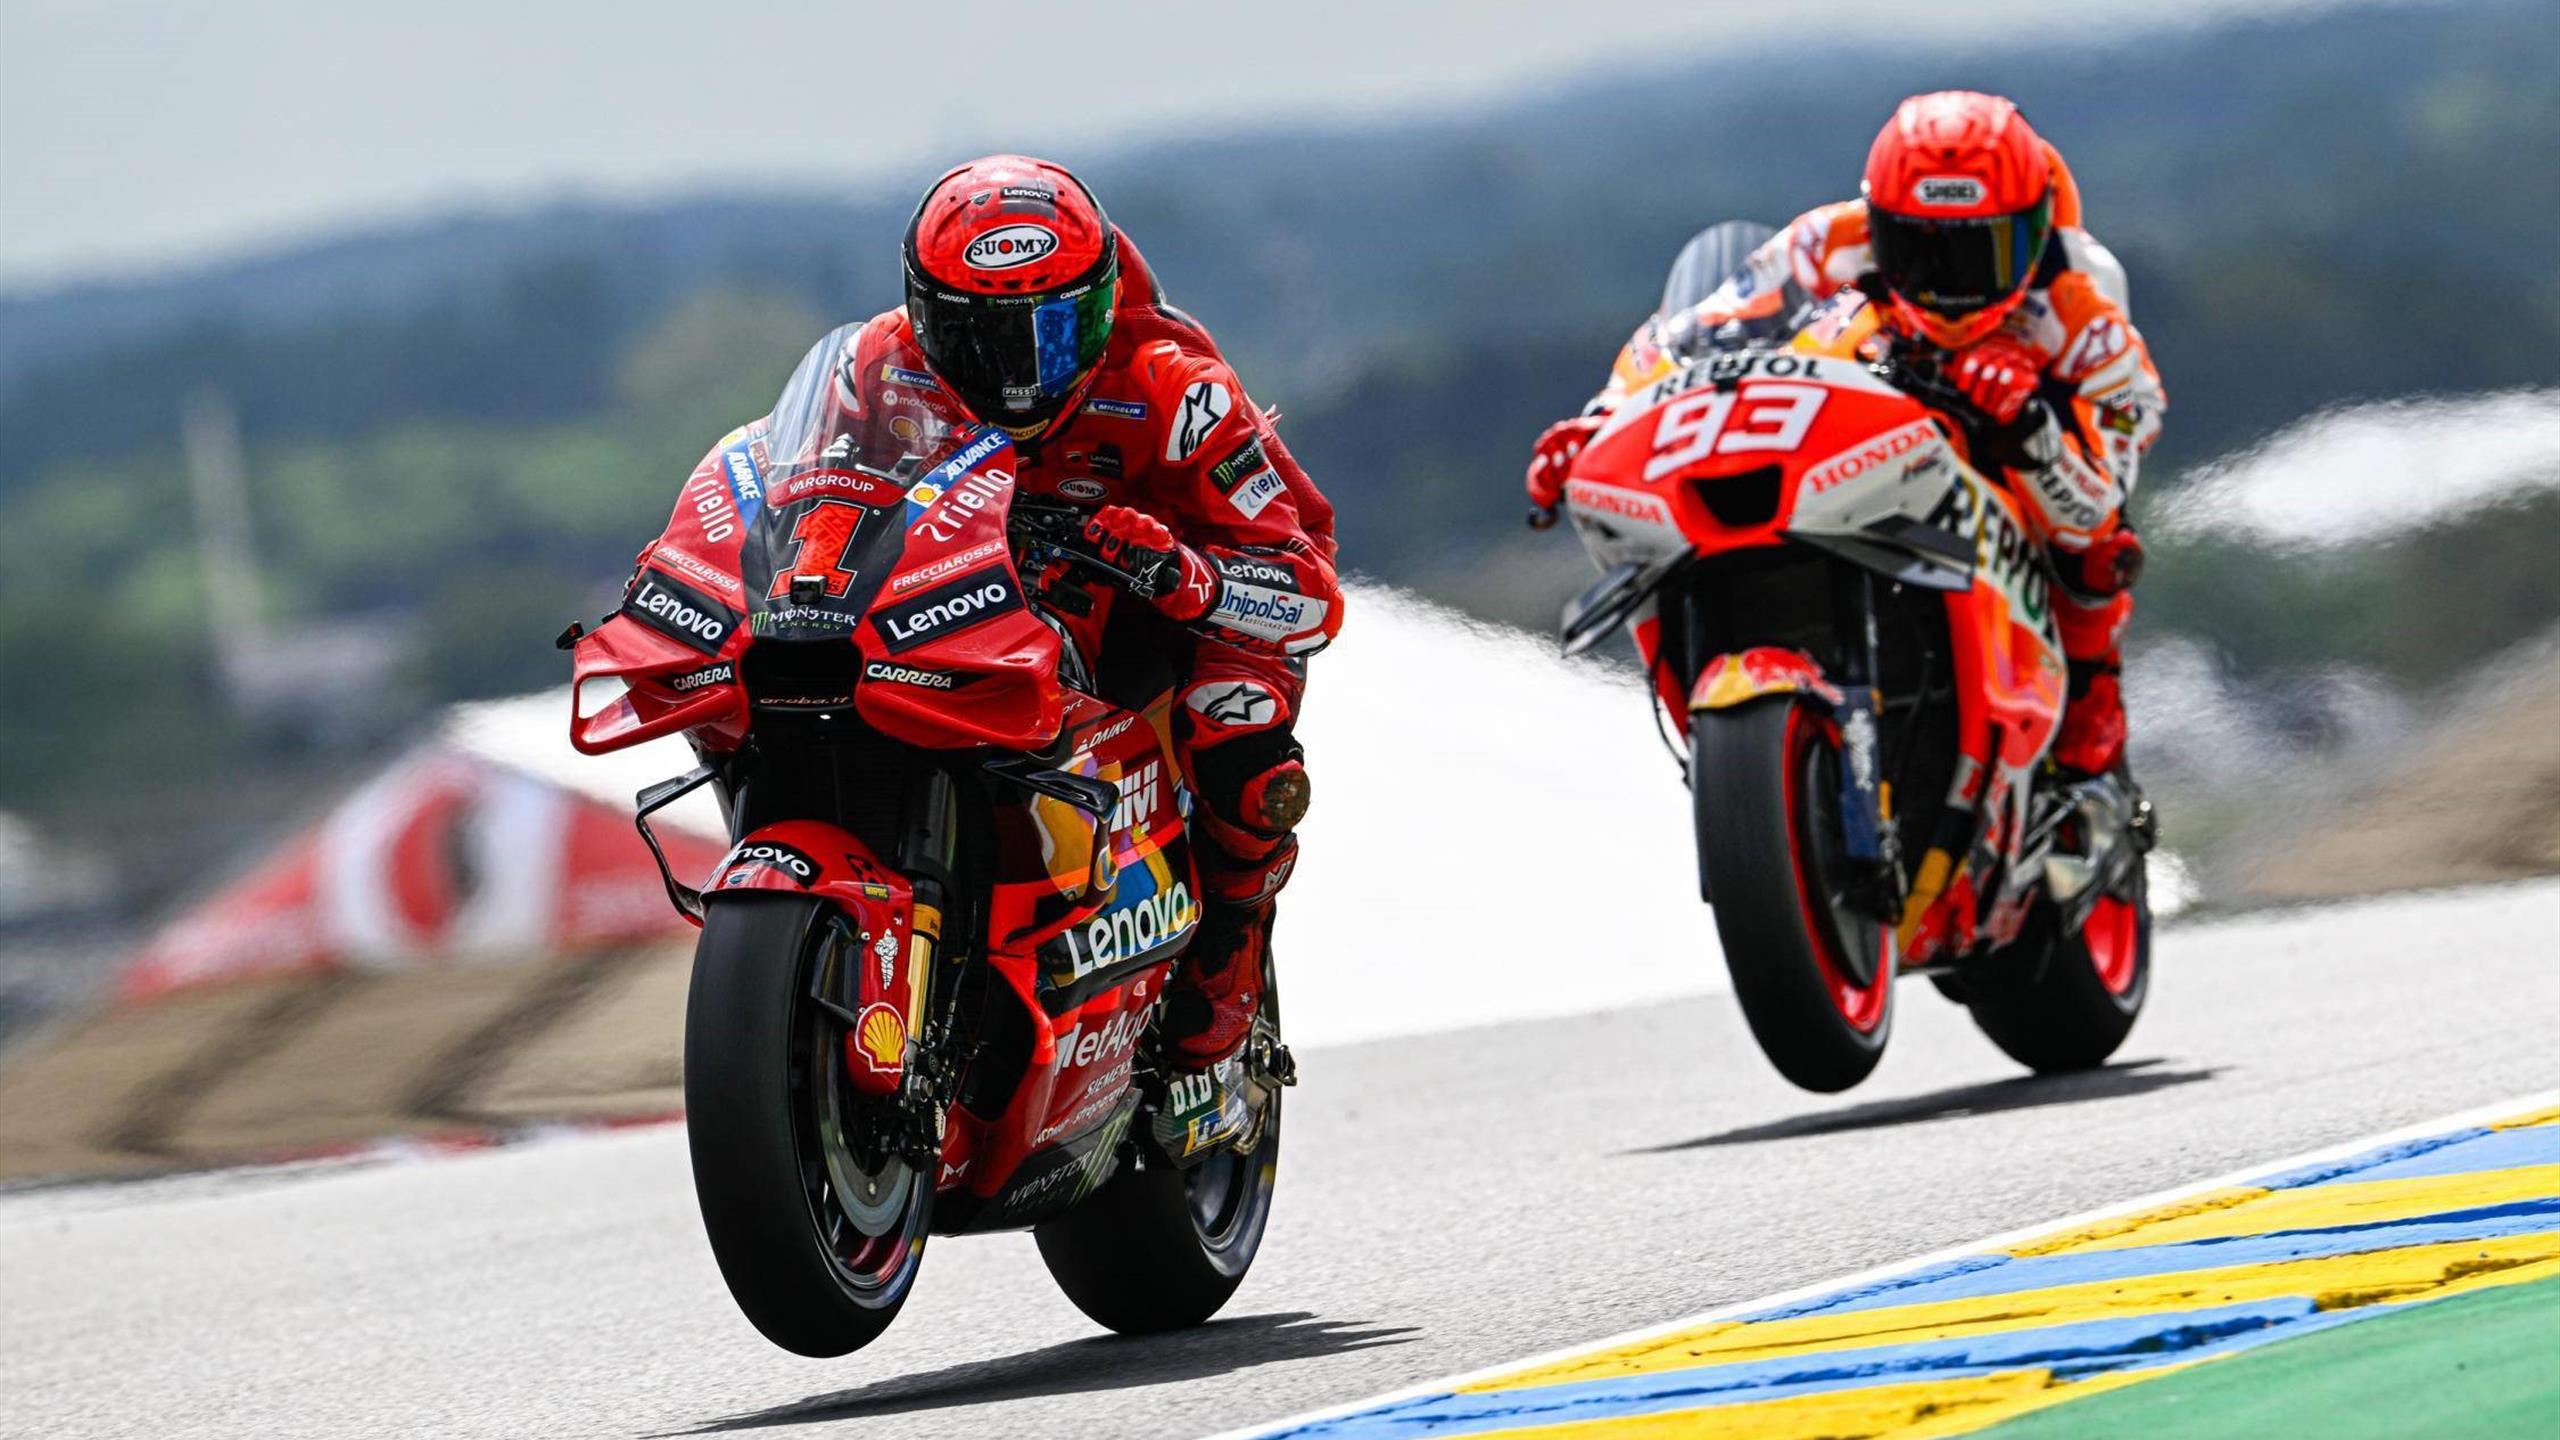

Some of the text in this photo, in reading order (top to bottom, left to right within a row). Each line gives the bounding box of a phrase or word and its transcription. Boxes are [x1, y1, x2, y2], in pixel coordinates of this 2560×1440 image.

[1003, 187, 1051, 201] Lenovo
[972, 239, 1050, 257] SUOMY
[936, 292, 971, 304] CARRERA
[1059, 284, 1092, 300] CARRERA
[900, 396, 948, 414] motorola
[1098, 403, 1141, 415] MICHELIN
[1642, 383, 1829, 483] 93
[944, 431, 1006, 481] ADVANCE
[1812, 424, 1937, 494] HONDA
[727, 451, 762, 500] ADVANCE
[789, 474, 875, 495] VARGROUP
[1569, 487, 1664, 525] HONDA
[765, 500, 867, 601] 1
[657, 546, 740, 593] FRECCIAROSSA
[893, 540, 1004, 593] FRECCIAROSSA
[1217, 559, 1293, 585] Lenovo
[635, 581, 723, 641] Lenovo
[769, 604, 857, 627] MONSTER
[779, 621, 843, 631] ENERGY
[887, 583, 1007, 641] Lenovo
[674, 665, 732, 692] CARRERA
[866, 663, 952, 690] CARRERA
[759, 695, 850, 705] aruba.it
[1089, 716, 1135, 749] DAIKO
[1065, 881, 1189, 979] Lenovo
[1170, 1065, 1213, 1117] D.I.D
